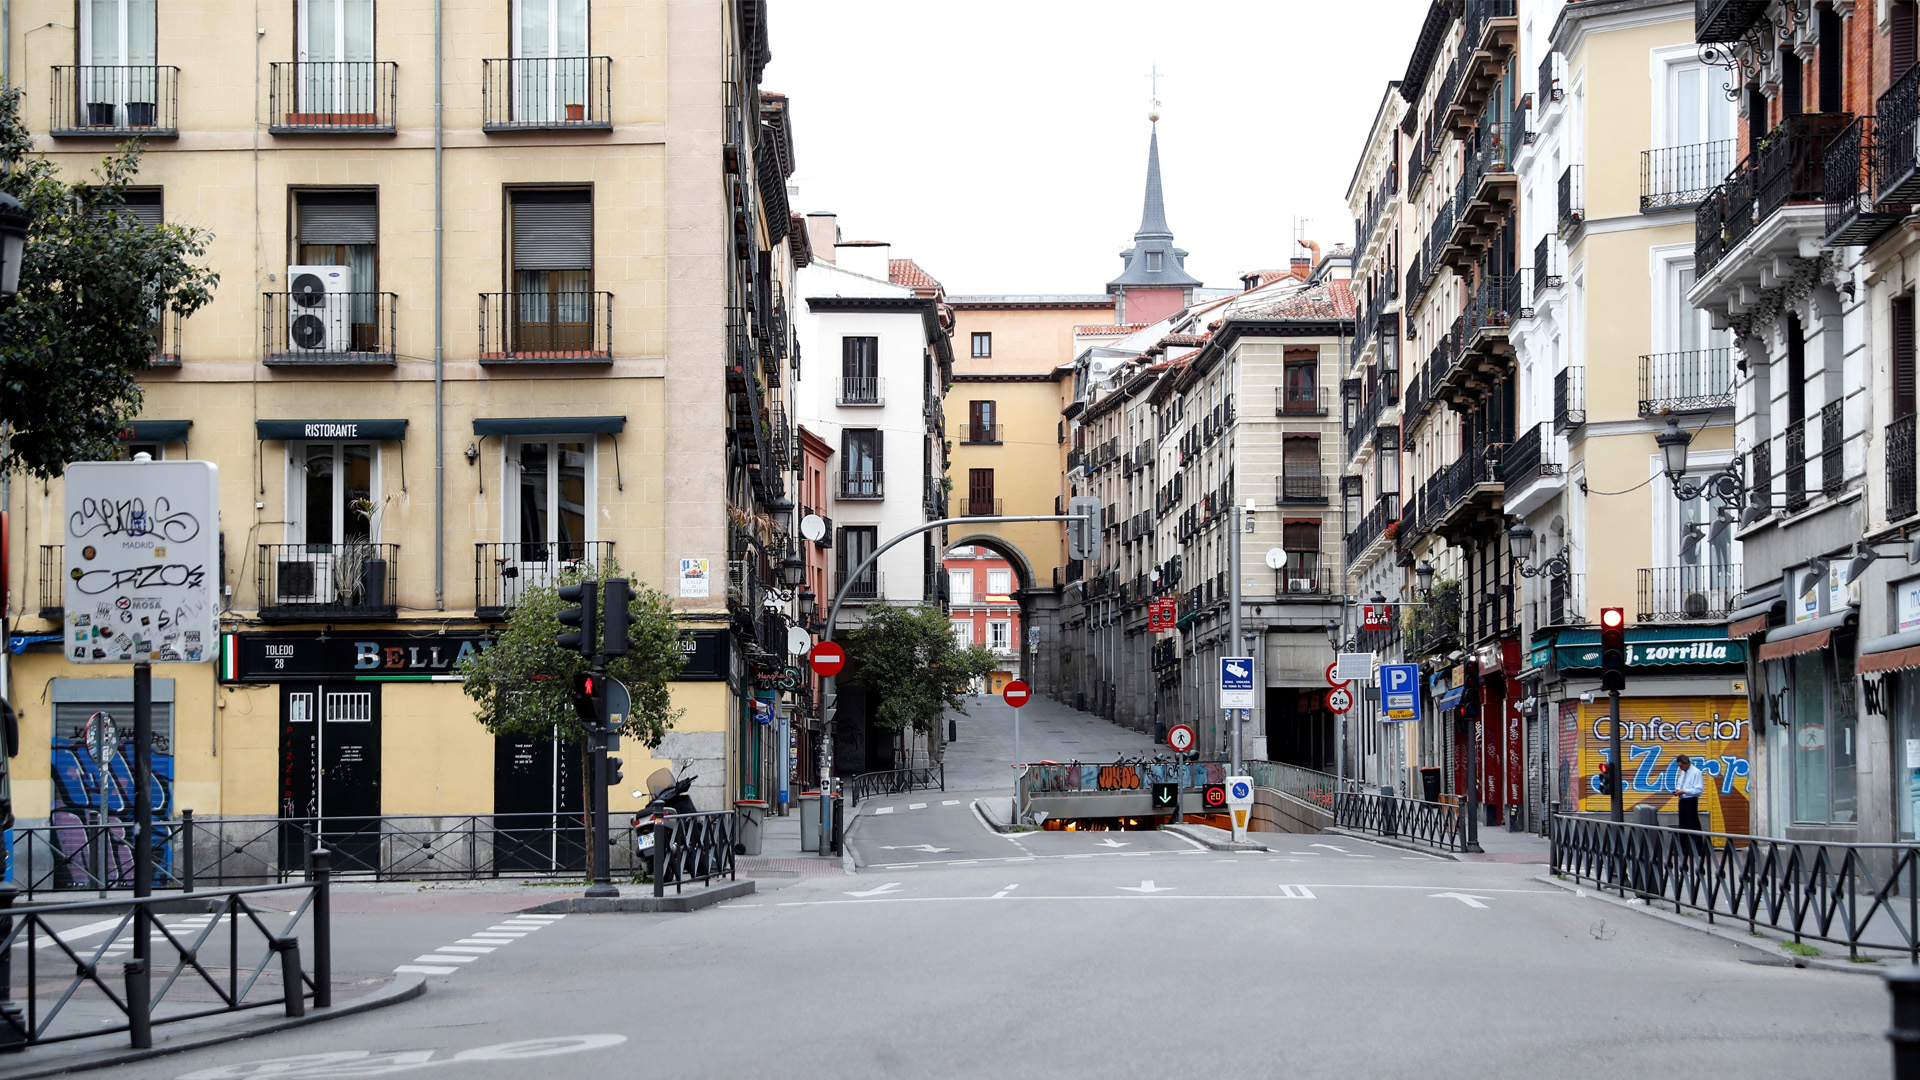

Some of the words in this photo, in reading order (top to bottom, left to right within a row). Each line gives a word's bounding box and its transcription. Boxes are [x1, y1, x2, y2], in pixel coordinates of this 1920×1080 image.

[305, 423, 358, 437] RISTORANTE
[122, 541, 154, 549] MADRID
[132, 601, 161, 609] MOSA
[265, 645, 294, 655] TOLEDO
[1646, 642, 1727, 660] zorrilla
[274, 659, 284, 669] 28
[1391, 670, 1407, 690] P
[1210, 792, 1220, 800] 20
